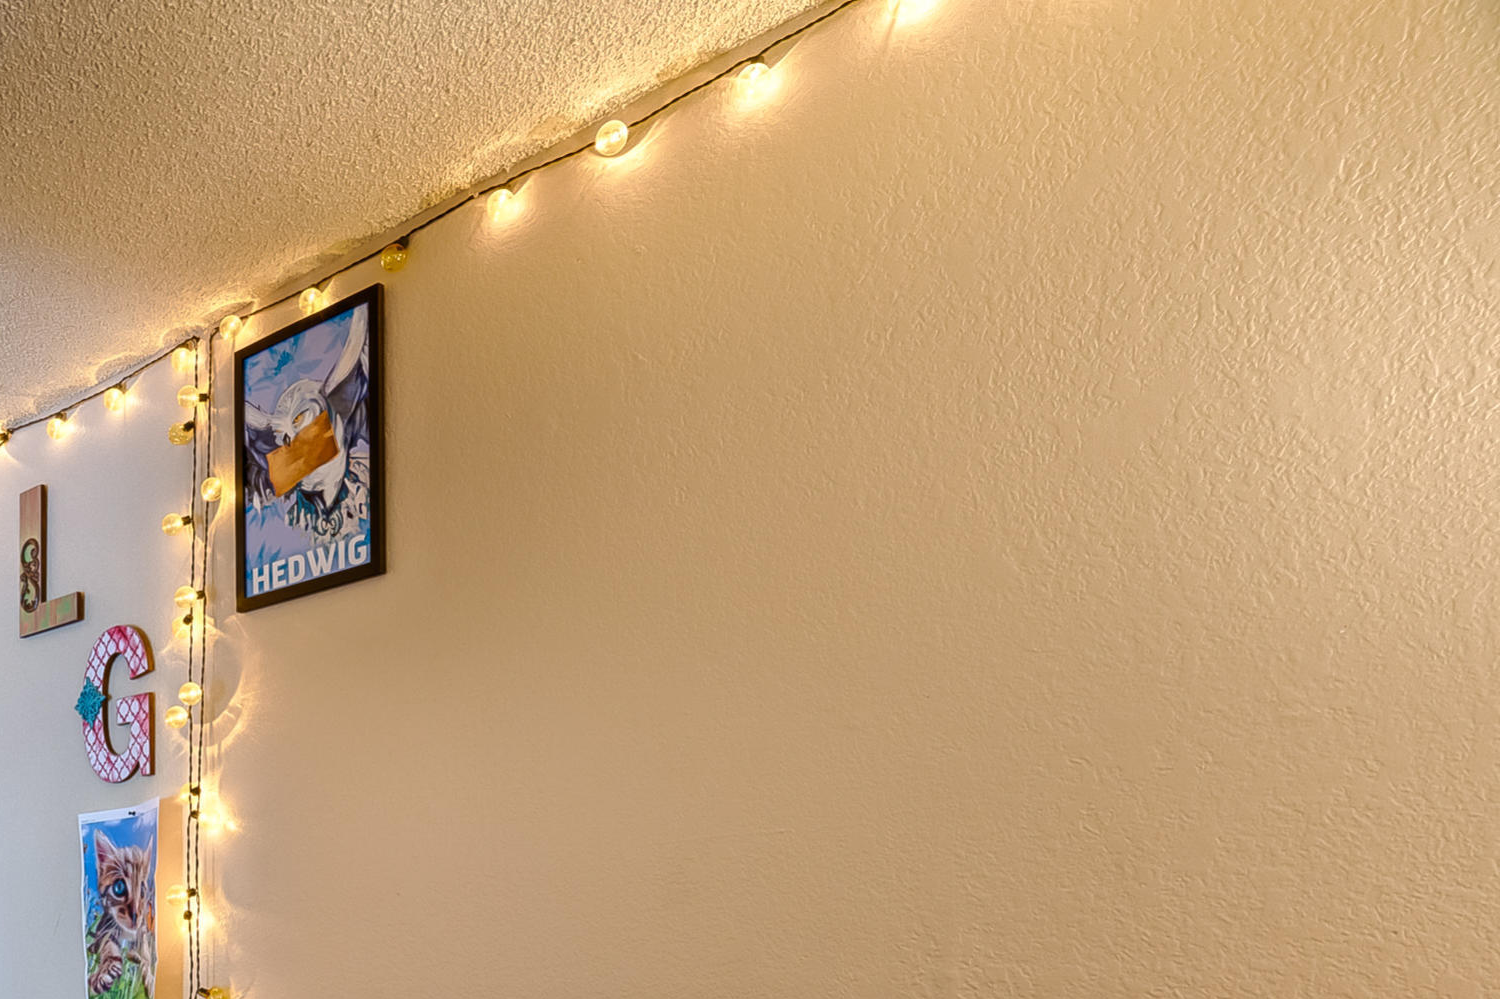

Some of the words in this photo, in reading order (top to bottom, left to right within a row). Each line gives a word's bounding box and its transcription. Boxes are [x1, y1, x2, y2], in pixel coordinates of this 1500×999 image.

[19, 484, 85, 638] L
[251, 534, 368, 595] HEDWIG
[75, 624, 155, 783] G
